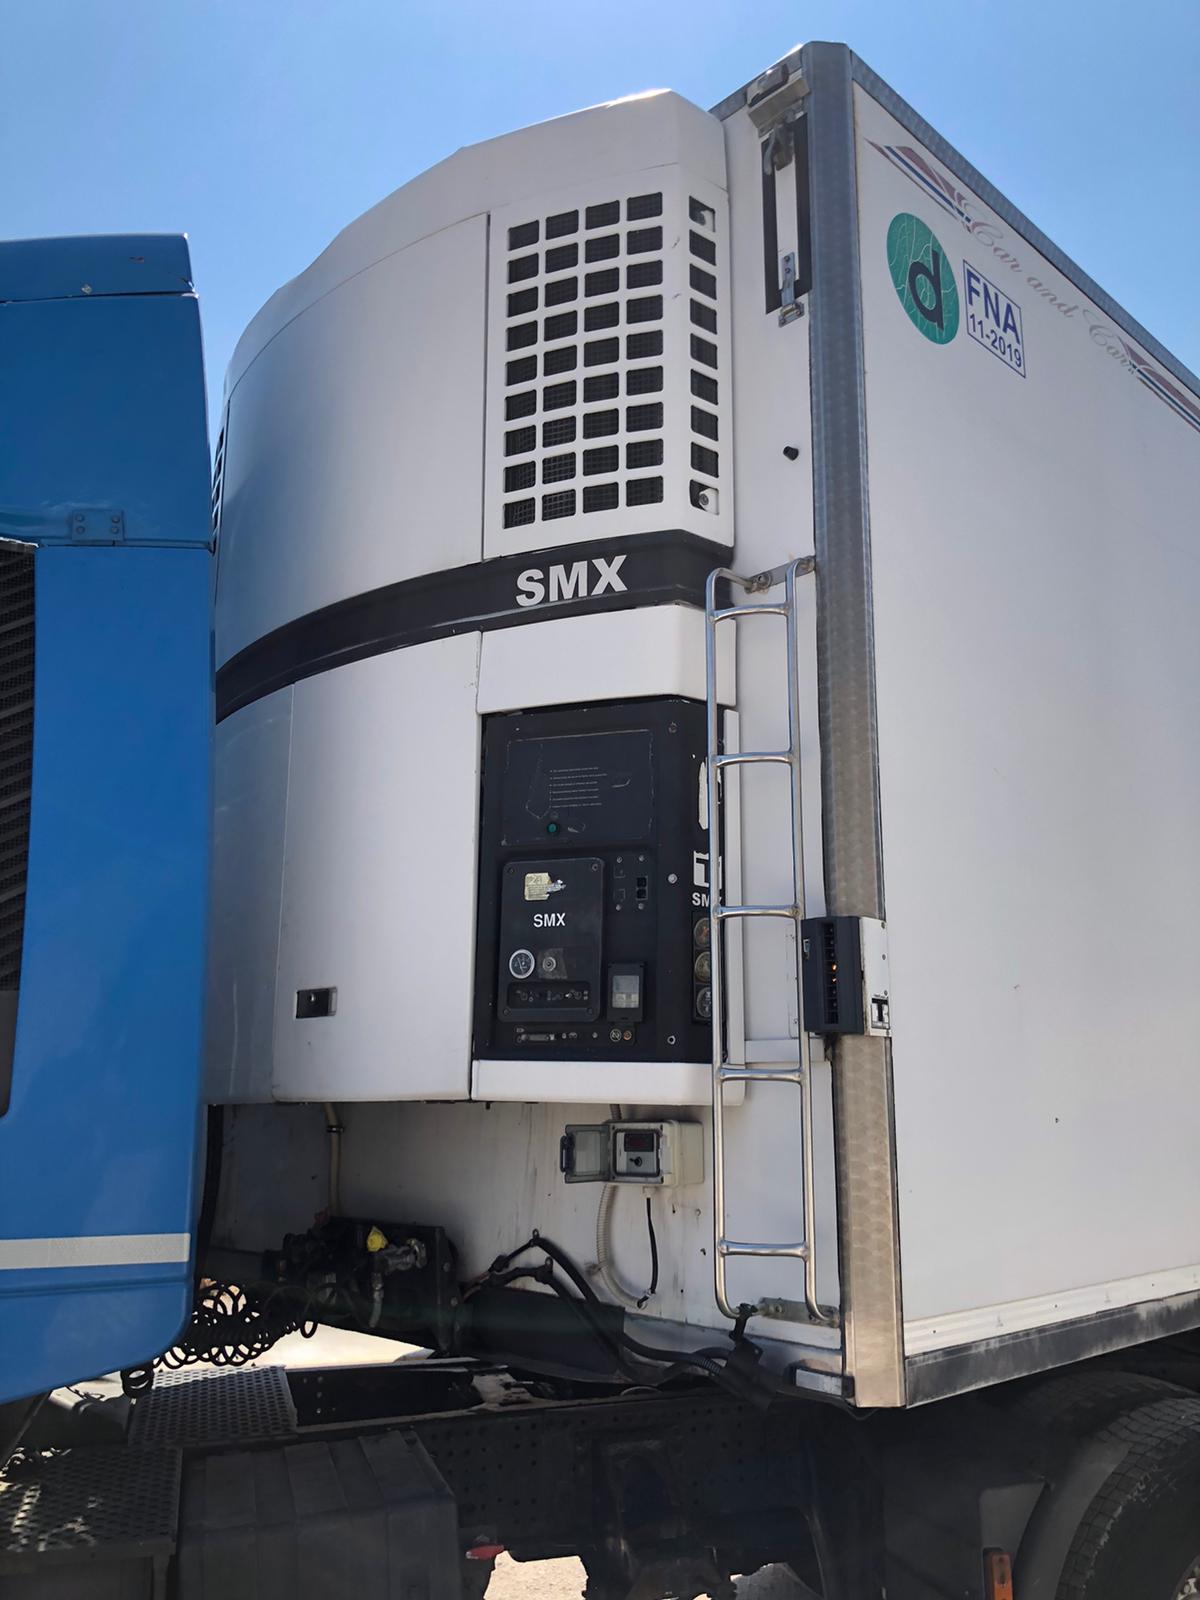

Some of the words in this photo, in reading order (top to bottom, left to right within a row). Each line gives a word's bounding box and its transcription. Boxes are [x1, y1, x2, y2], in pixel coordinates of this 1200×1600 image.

[966, 269, 1021, 346] FNA
[969, 314, 1023, 369] 11-2019
[515, 554, 628, 607] SMX
[533, 912, 566, 929] SMX
